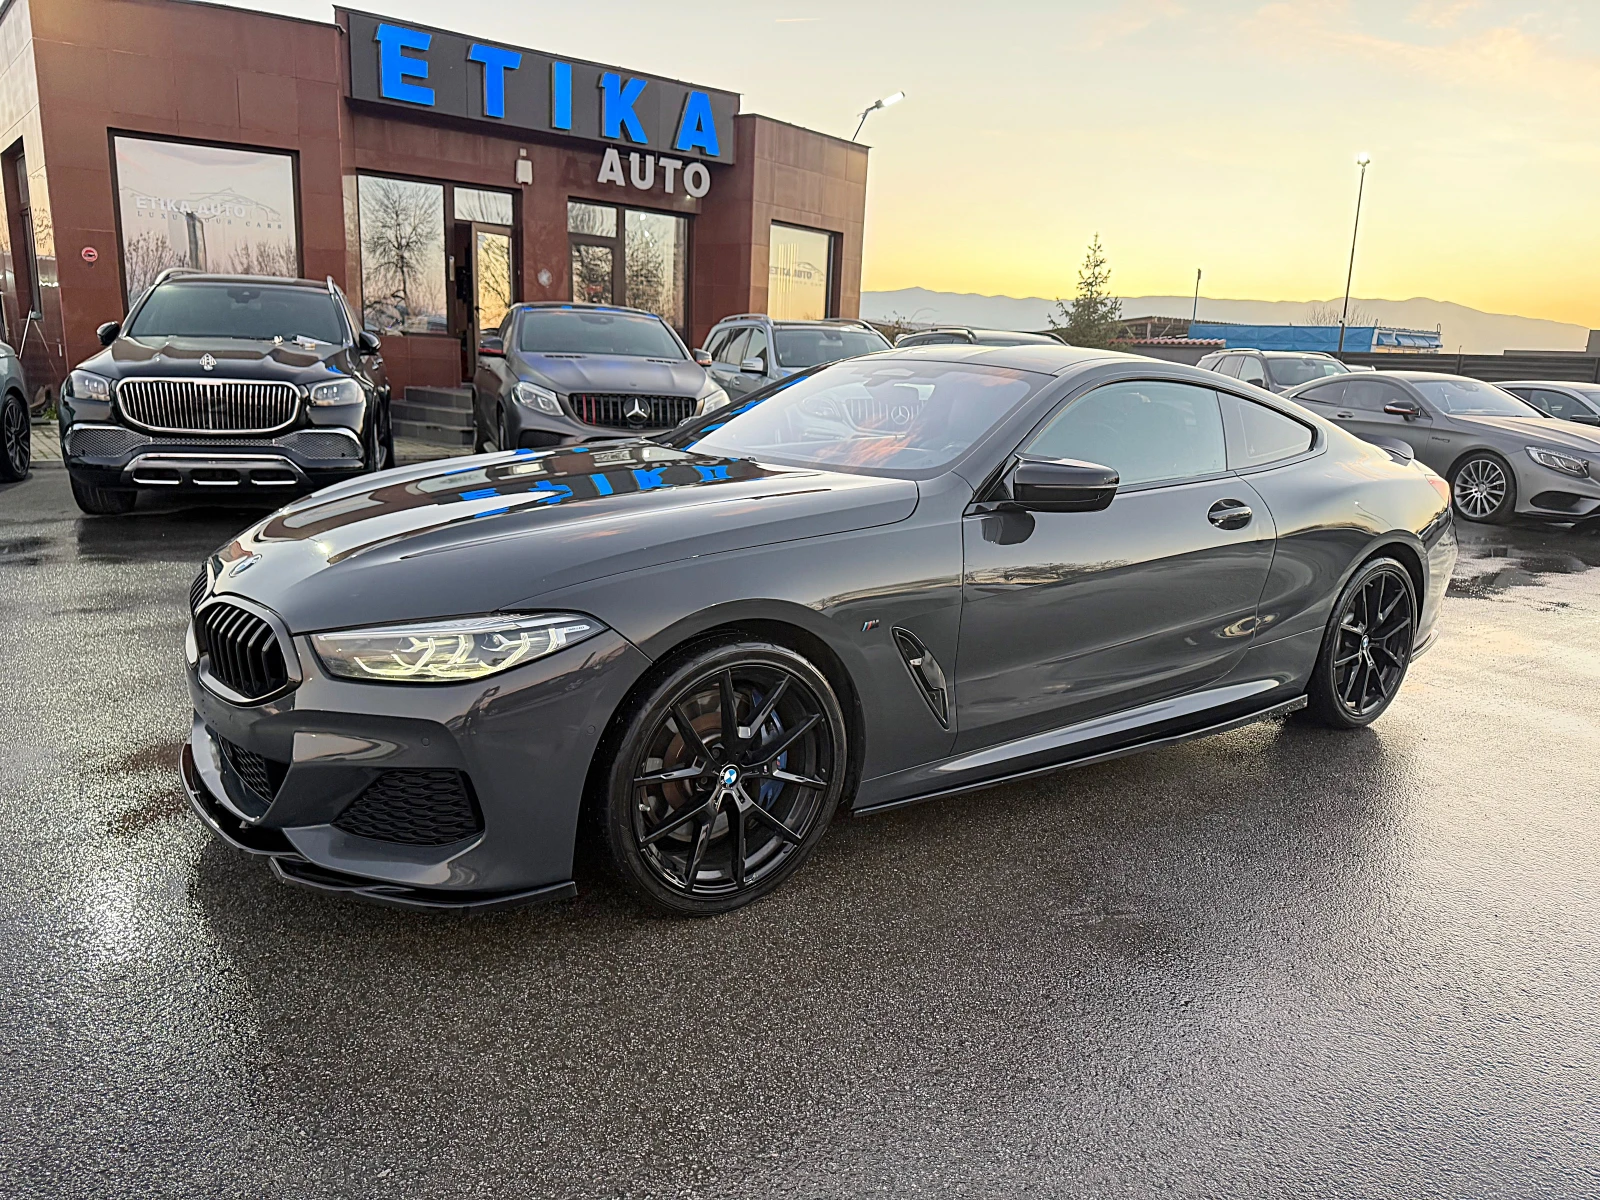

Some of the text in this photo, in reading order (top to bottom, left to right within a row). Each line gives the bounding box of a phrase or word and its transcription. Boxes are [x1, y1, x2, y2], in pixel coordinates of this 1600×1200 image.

[374, 23, 720, 156] ETIKA
[597, 147, 711, 198] AUTO
[135, 196, 246, 218] ETIKA AUTO
[137, 210, 232, 225] LUXUOUS
